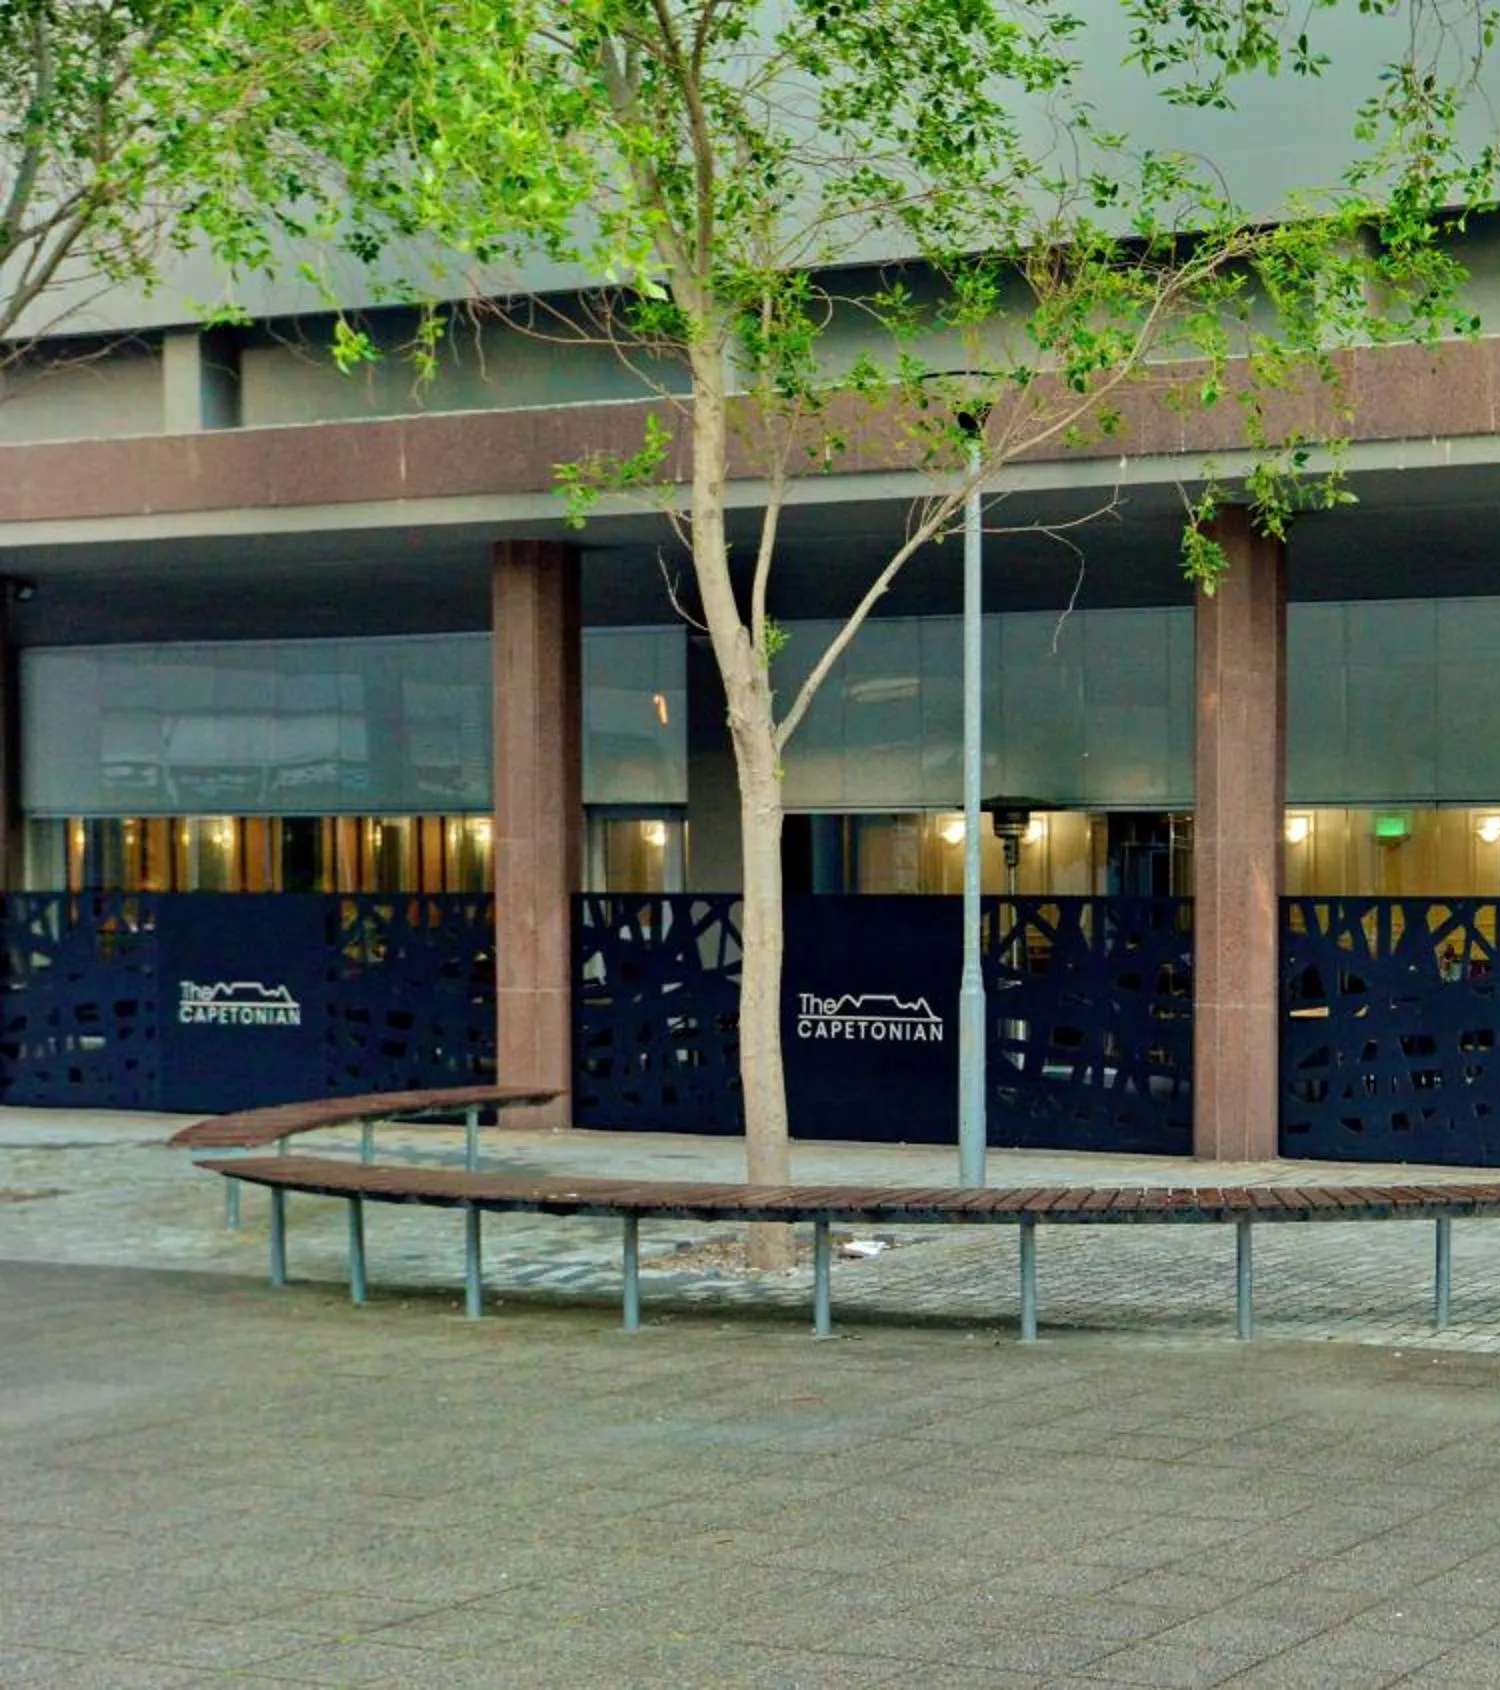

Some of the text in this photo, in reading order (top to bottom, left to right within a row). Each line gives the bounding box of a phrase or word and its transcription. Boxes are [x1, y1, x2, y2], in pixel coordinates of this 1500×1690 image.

[180, 981, 213, 1001] The
[799, 993, 836, 1015] The
[180, 1006, 301, 1025] CAPETONIAN
[797, 1021, 943, 1041] CAPETONIAN
